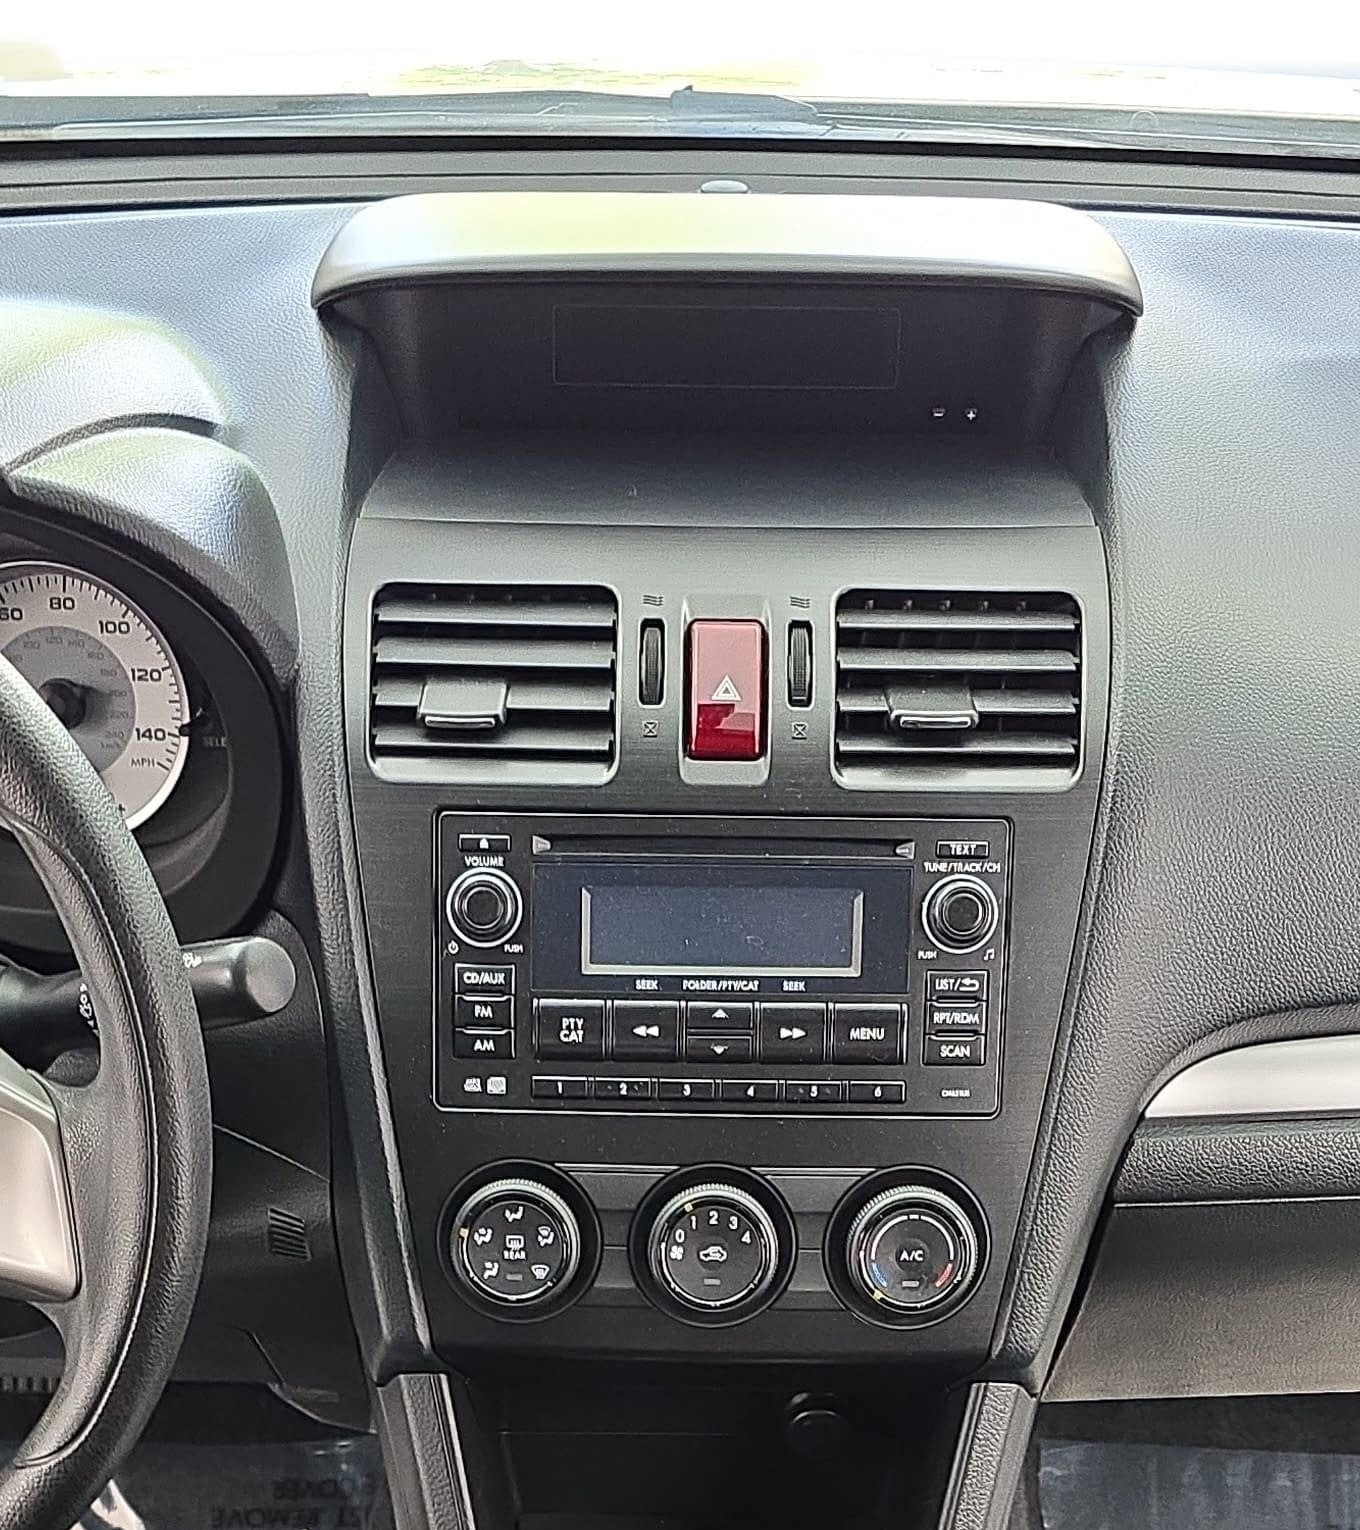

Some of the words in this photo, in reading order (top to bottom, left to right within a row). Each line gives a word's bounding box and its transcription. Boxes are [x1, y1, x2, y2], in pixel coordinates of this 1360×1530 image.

[49, 597, 75, 611] 80
[99, 620, 131, 635] 100
[131, 668, 162, 682] 120
[135, 727, 166, 742] 140
[131, 757, 156, 769] MPH
[950, 844, 976, 856] TEXT
[464, 855, 504, 867] VOLUME
[923, 861, 1001, 873] TUNE/TRACK/CH
[463, 971, 505, 985] CD/AUX
[635, 979, 660, 991] SEEK
[682, 979, 760, 991] FOLDER/PTY/CAT
[782, 980, 806, 992] SEEK
[474, 1004, 493, 1018] FM
[561, 1017, 584, 1030] PTY
[933, 1012, 980, 1025] RPT/RDM
[559, 1030, 584, 1043] CAT
[849, 1027, 885, 1041] MENU
[473, 1039, 495, 1052] AM
[940, 1045, 971, 1058] SCAN
[557, 1081, 563, 1094] 1
[619, 1083, 628, 1095] 2
[683, 1084, 691, 1096] 3
[746, 1084, 755, 1097] 4
[810, 1085, 818, 1097] 5
[874, 1086, 882, 1098] 6
[691, 1215, 697, 1230] 1
[709, 1210, 719, 1225] 2
[728, 1215, 738, 1230] 3
[675, 1228, 685, 1243] 0
[741, 1230, 752, 1244] 4
[900, 1249, 924, 1261] A/C
